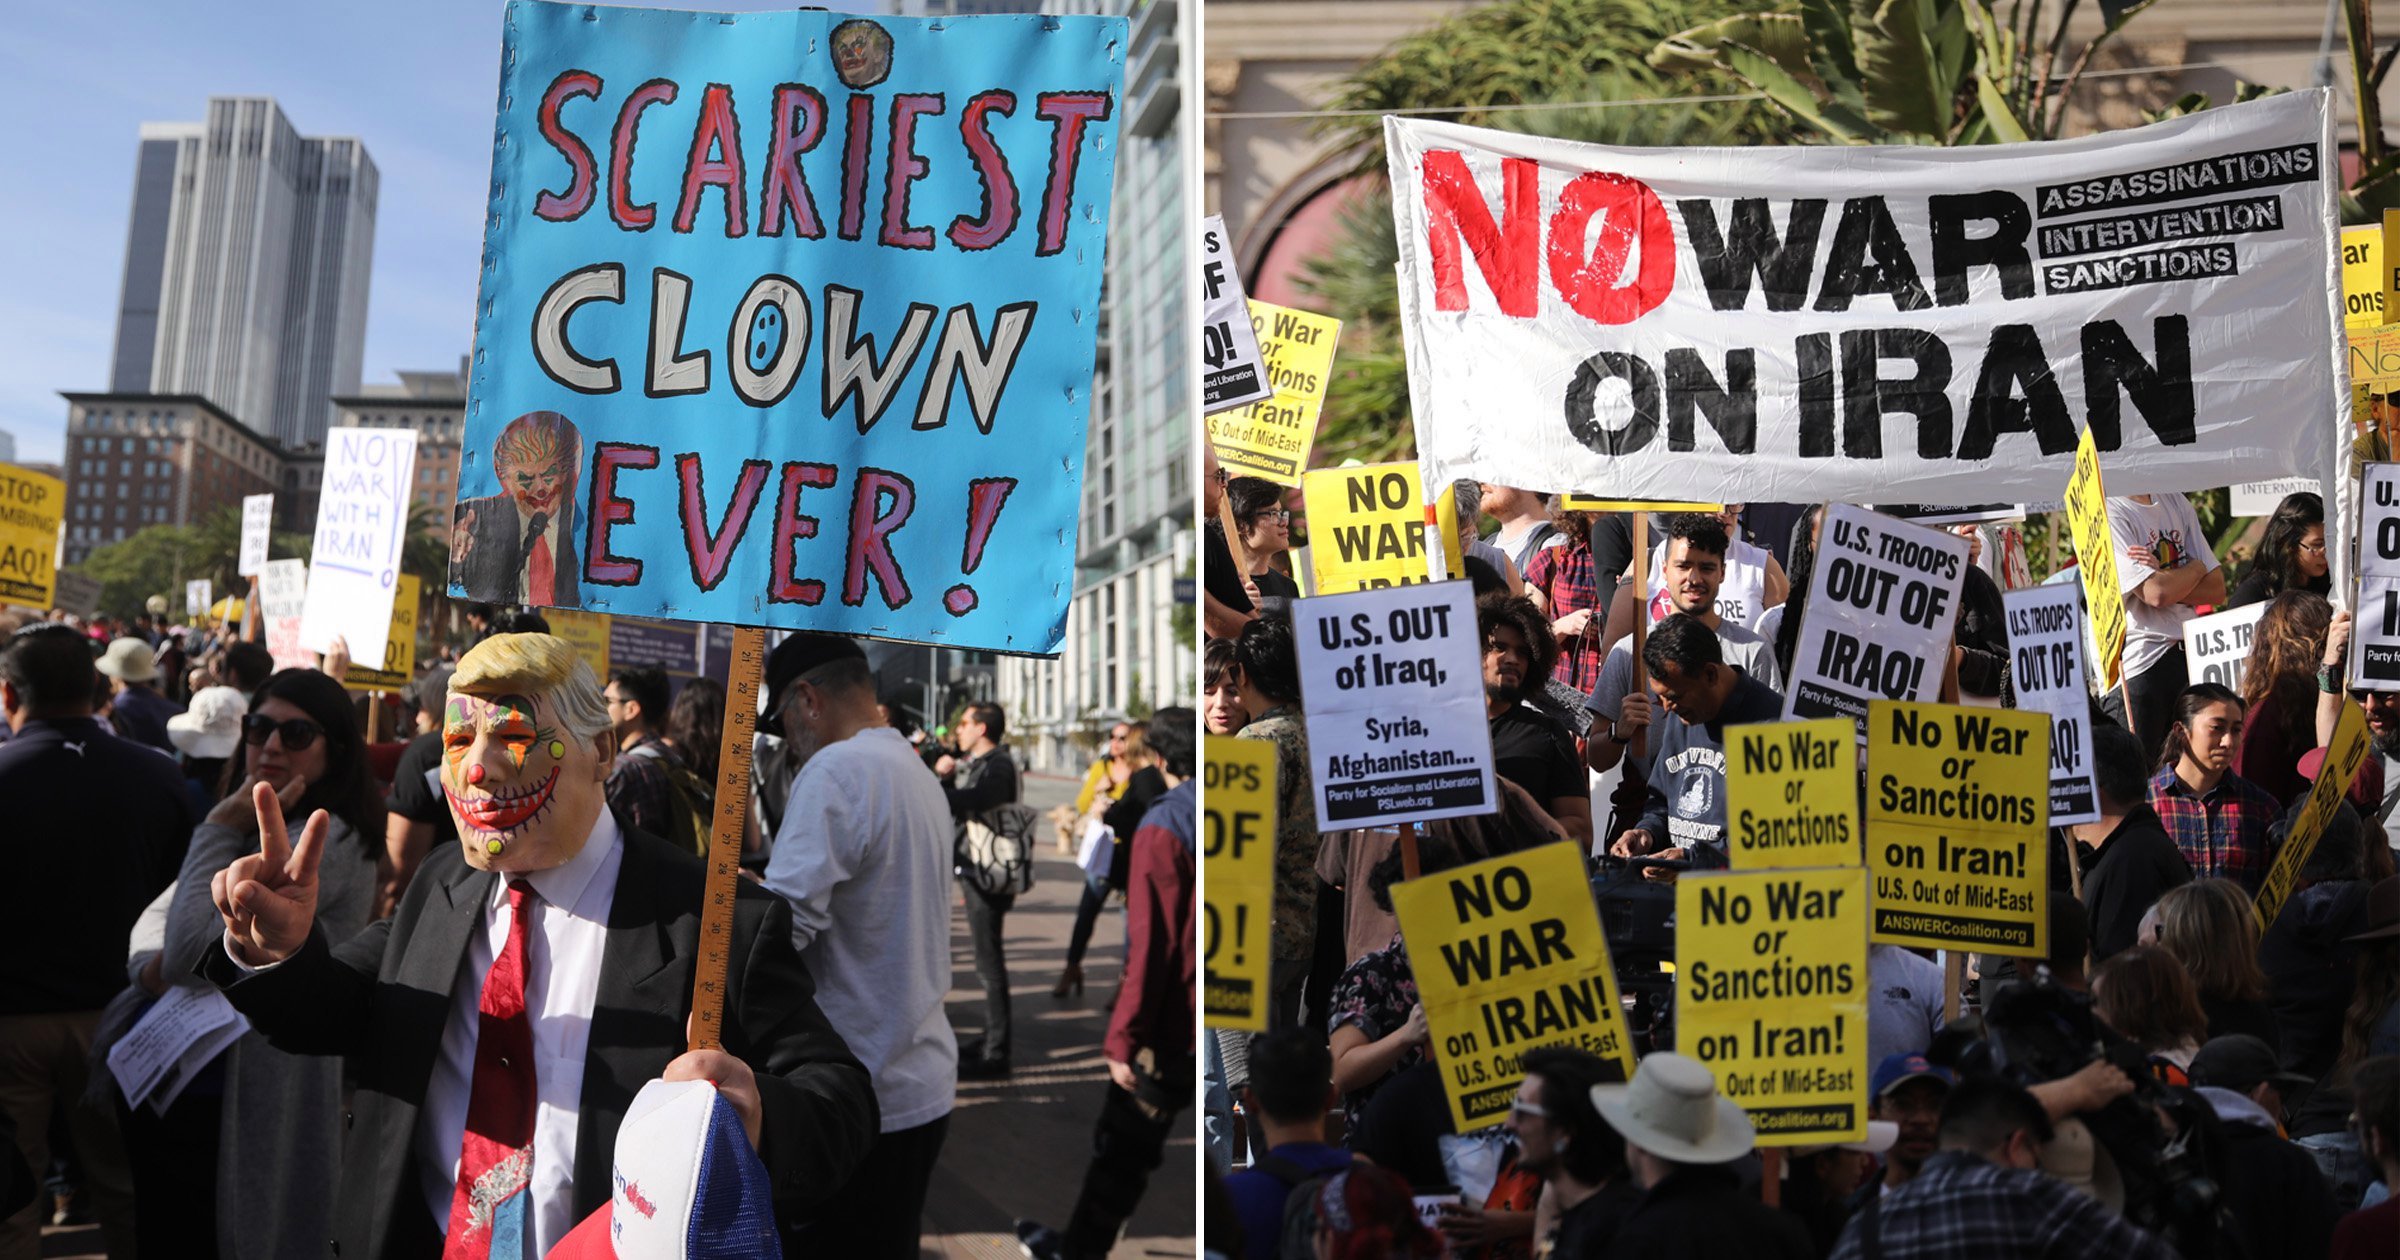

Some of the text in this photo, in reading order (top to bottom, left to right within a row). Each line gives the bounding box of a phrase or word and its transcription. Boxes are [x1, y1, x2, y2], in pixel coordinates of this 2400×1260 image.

[533, 69, 1113, 257] SCARIEST
[2042, 148, 2313, 213] ASSASSINATIONS
[1421, 149, 2036, 326] NO WAR
[2045, 201, 2278, 254] INTERVENTION
[2049, 248, 2232, 290] SANCTIONS
[532, 262, 1038, 436] CLOWN
[1262, 340, 1282, 358] or
[1274, 312, 1322, 346] War
[1218, 369, 1254, 385] Liberation
[1563, 313, 2198, 460] ON IRAN
[340, 433, 387, 467] NO
[1223, 421, 1240, 440] Out
[1242, 425, 1253, 442] of
[1256, 428, 1302, 453] Mid-East
[329, 469, 391, 501] WAR
[1346, 472, 1410, 514] NO
[323, 502, 382, 526] WITH
[319, 530, 373, 560] IRAN
[1333, 521, 1427, 564] WAR
[1833, 519, 1959, 582] U.S. TROOPS
[1826, 557, 1950, 631] OUT OF
[1319, 604, 1451, 651] U.S. OUT
[2009, 605, 2031, 638] U.S.
[2031, 602, 2073, 635] TROOPS
[2195, 629, 2231, 657] U.S.
[2367, 650, 2392, 663] Party
[1336, 652, 1447, 691] of Iraq,
[1817, 629, 1925, 702] IRAQ!
[2018, 641, 2075, 693] OUT OF
[1801, 686, 1867, 716] Party for Socialism
[1365, 715, 1429, 744] Syria,
[1892, 709, 1942, 750] No
[1954, 714, 2029, 756] War
[1328, 749, 1475, 780] Afghanistan...
[1742, 731, 1839, 775] No War
[1941, 757, 1975, 781] or
[1328, 775, 1480, 802] Party for Socialism and Liberation
[1378, 796, 1434, 811] PSLweb.org
[1785, 779, 1804, 805] or
[1880, 774, 2036, 826] Sanctions
[1740, 807, 1849, 851] Sanctions
[1885, 835, 2026, 879] on Iran!
[1448, 866, 1532, 925] NO
[1700, 881, 1844, 926] No War
[1877, 876, 2034, 913] U.S. Out of Mid-East
[1754, 929, 1787, 955] or
[1883, 914, 2028, 944] ANSWERCoalition.org
[1440, 918, 1576, 988] WAR
[1691, 956, 1854, 1001] Sanctions
[1446, 976, 1611, 1058] on IRAN!
[1698, 1014, 1844, 1062] on Iran!
[1454, 1059, 1492, 1088] U.S.
[1494, 1053, 1524, 1080] Out
[1727, 1067, 1854, 1097] Out of Mid-East
